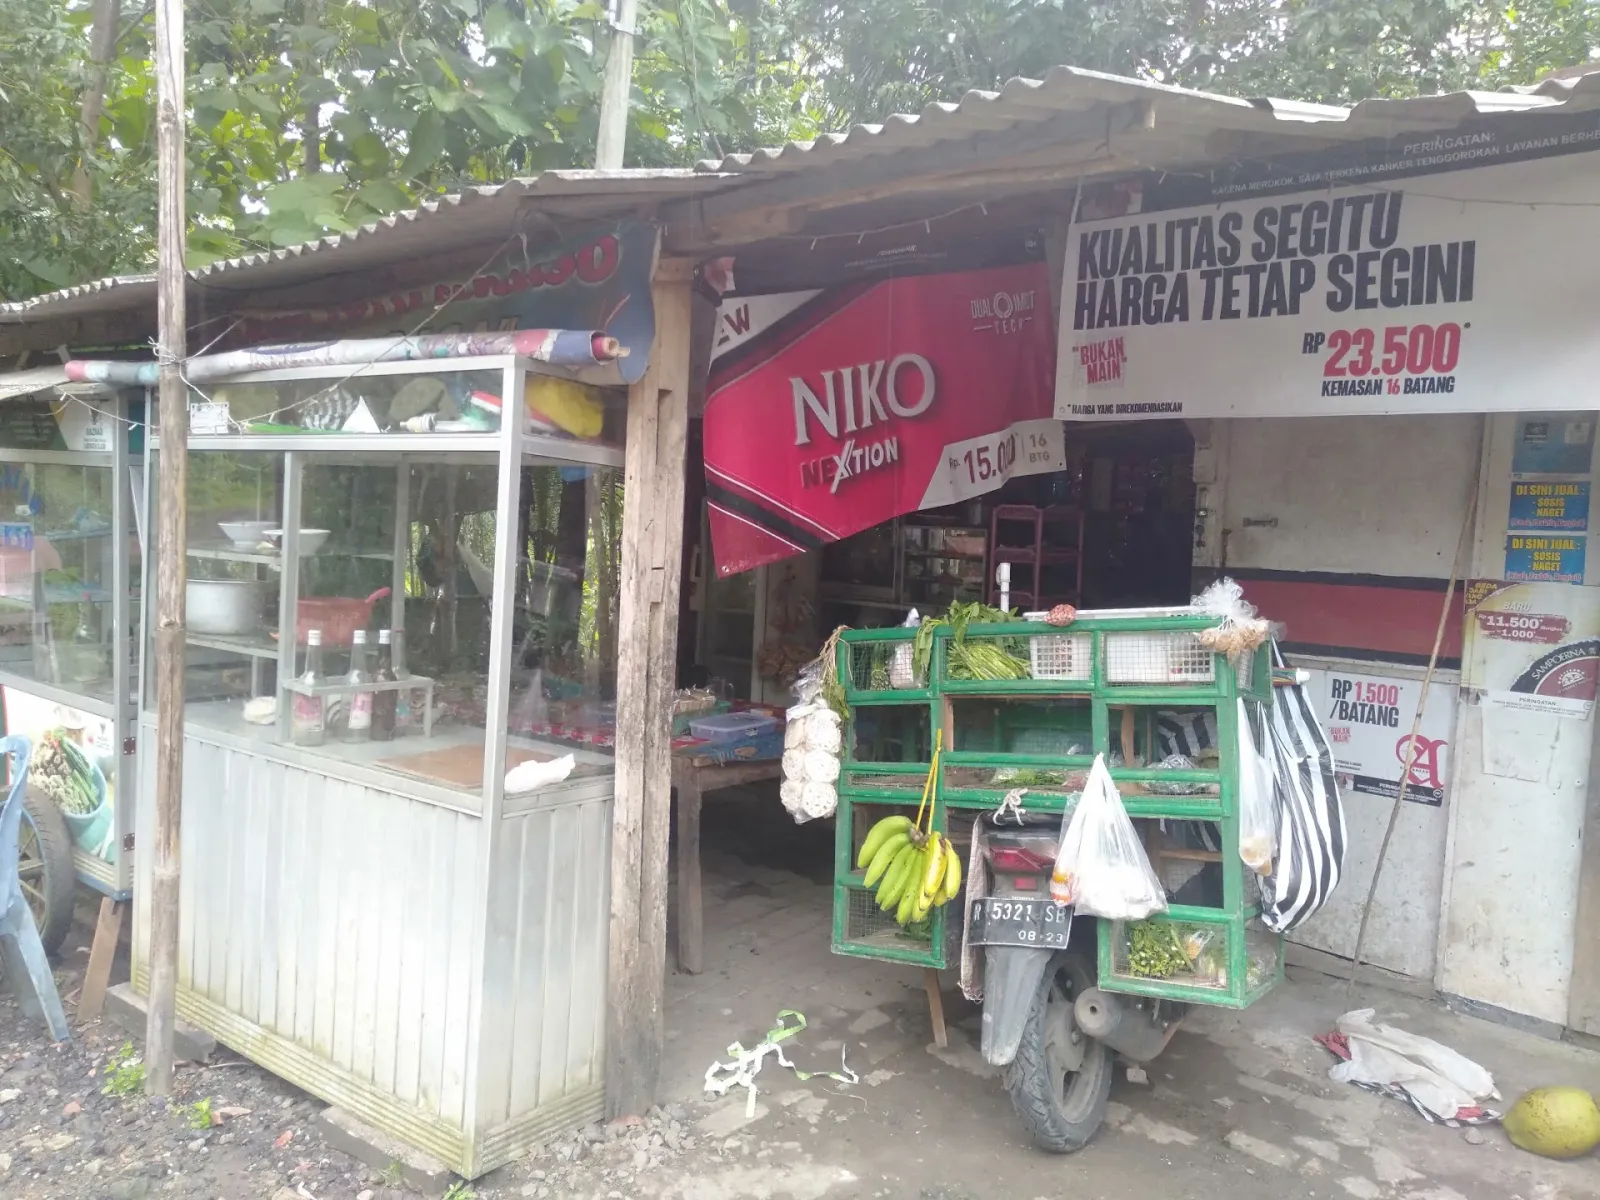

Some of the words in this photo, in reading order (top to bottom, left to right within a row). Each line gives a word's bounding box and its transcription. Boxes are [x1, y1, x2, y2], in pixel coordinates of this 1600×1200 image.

[1404, 132, 1495, 155] PERINGATAN:
[1325, 167, 1369, 181] TERKENA
[1371, 160, 1413, 173] KANKER
[1505, 137, 1558, 153] LAYANAN
[1077, 211, 1243, 281] KUALITAS
[1251, 189, 1404, 263] SEGITU
[1073, 272, 1190, 330] HARGA
[1200, 259, 1316, 320] TETAP
[1326, 240, 1476, 313] SEGINI
[1302, 332, 1325, 354] RP
[1321, 379, 1383, 397] KEMASAN
[1387, 378, 1400, 395] 16
[1403, 376, 1455, 395] BATANG
[788, 353, 935, 446] NIKO
[1097, 403, 1114, 415] YANG
[1116, 402, 1183, 414] DIREKOMENDASIKAN
[1029, 433, 1047, 448] 16
[800, 436, 898, 494] NEXTION
[1029, 451, 1050, 463] BTG
[1516, 485, 1527, 496] DI
[1530, 485, 1551, 496] SINI
[1512, 538, 1523, 549] DI
[1526, 538, 1548, 549] SINI
[1503, 602, 1532, 612] BARU
[1532, 647, 1586, 680] SAMPOERNA
[1331, 679, 1352, 699] RP
[1330, 700, 1399, 728] /BATANG
[992, 903, 1032, 922] 5321
